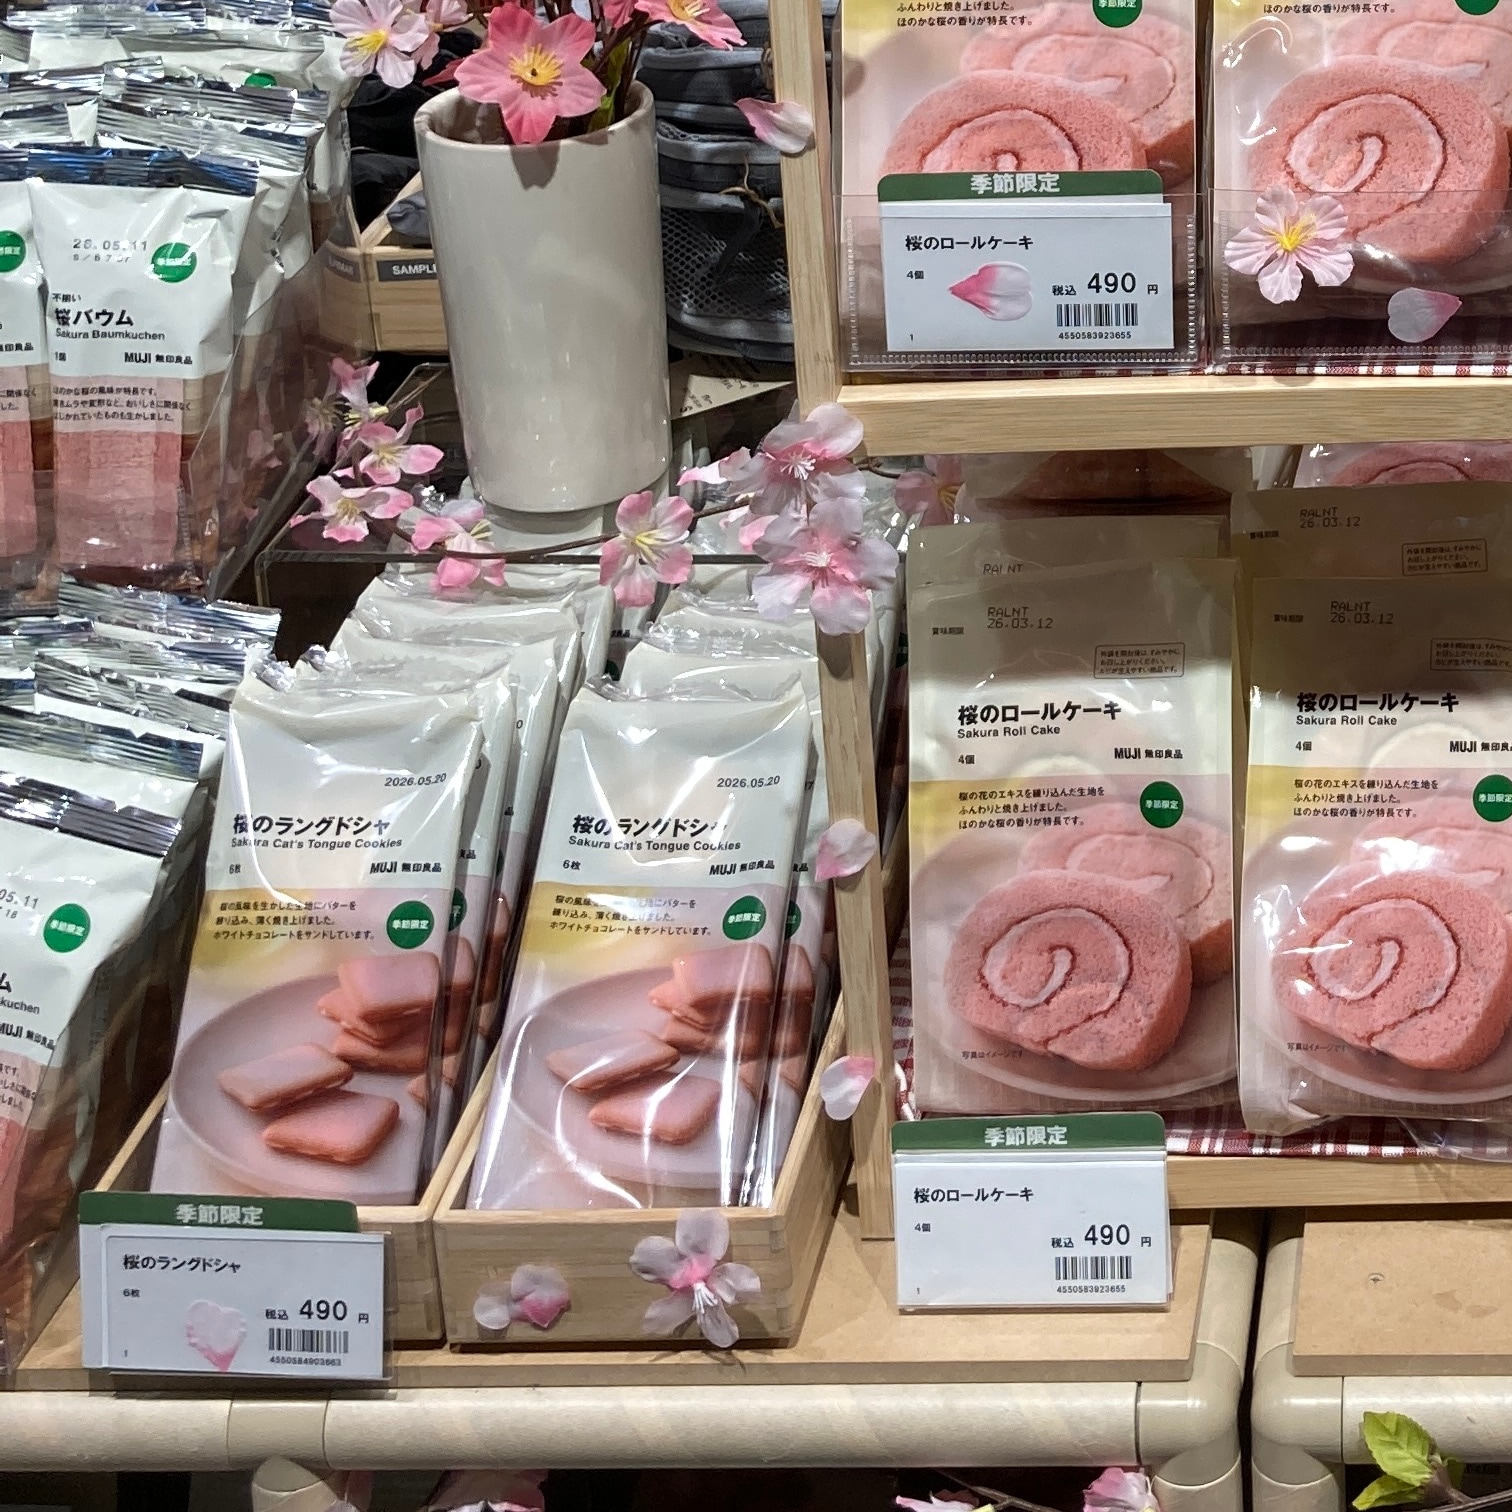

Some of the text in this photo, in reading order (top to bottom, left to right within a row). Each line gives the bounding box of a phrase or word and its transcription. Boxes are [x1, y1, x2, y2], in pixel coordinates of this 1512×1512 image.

[905, 234, 1034, 252] 桜のロールケーキ
[55, 308, 134, 327] 桜バウム
[56, 328, 165, 341] Sakura Baumkuchen
[1058, 331, 1132, 340] 4550583923655
[124, 352, 193, 365] MUJI 無印良品
[987, 617, 1053, 629] 26.03.12
[1297, 692, 1460, 713] 桜のロールケーキ
[958, 700, 1122, 726] 桜のロールケーキ
[1296, 715, 1397, 726] Sakura Roll Cake
[1449, 741, 1477, 753] MUJI
[384, 772, 446, 787] 2026.05.20
[717, 775, 781, 788] 2026.05.20
[1294, 778, 1439, 790] 桜の花のエキスを練り込んだ生地を
[1294, 793, 1401, 804] ふんわりと焼き上げました。
[1293, 807, 1417, 818] ほのかな桜の香りが特長です。
[272, 838, 304, 849] Cat's
[307, 840, 352, 850] Tongue
[354, 838, 402, 848] Cookies
[568, 835, 610, 849] Sakura
[646, 840, 690, 853] Tongue
[914, 1187, 1034, 1203] 桜のロールケーキ
[175, 1204, 264, 1226] 季節限定
[1051, 1224, 1151, 1249] 税込 490 円
[123, 1253, 241, 1273] 桜のラングドシャ
[123, 1288, 140, 1298] 6枚
[265, 1300, 369, 1324] 税込 490 円
